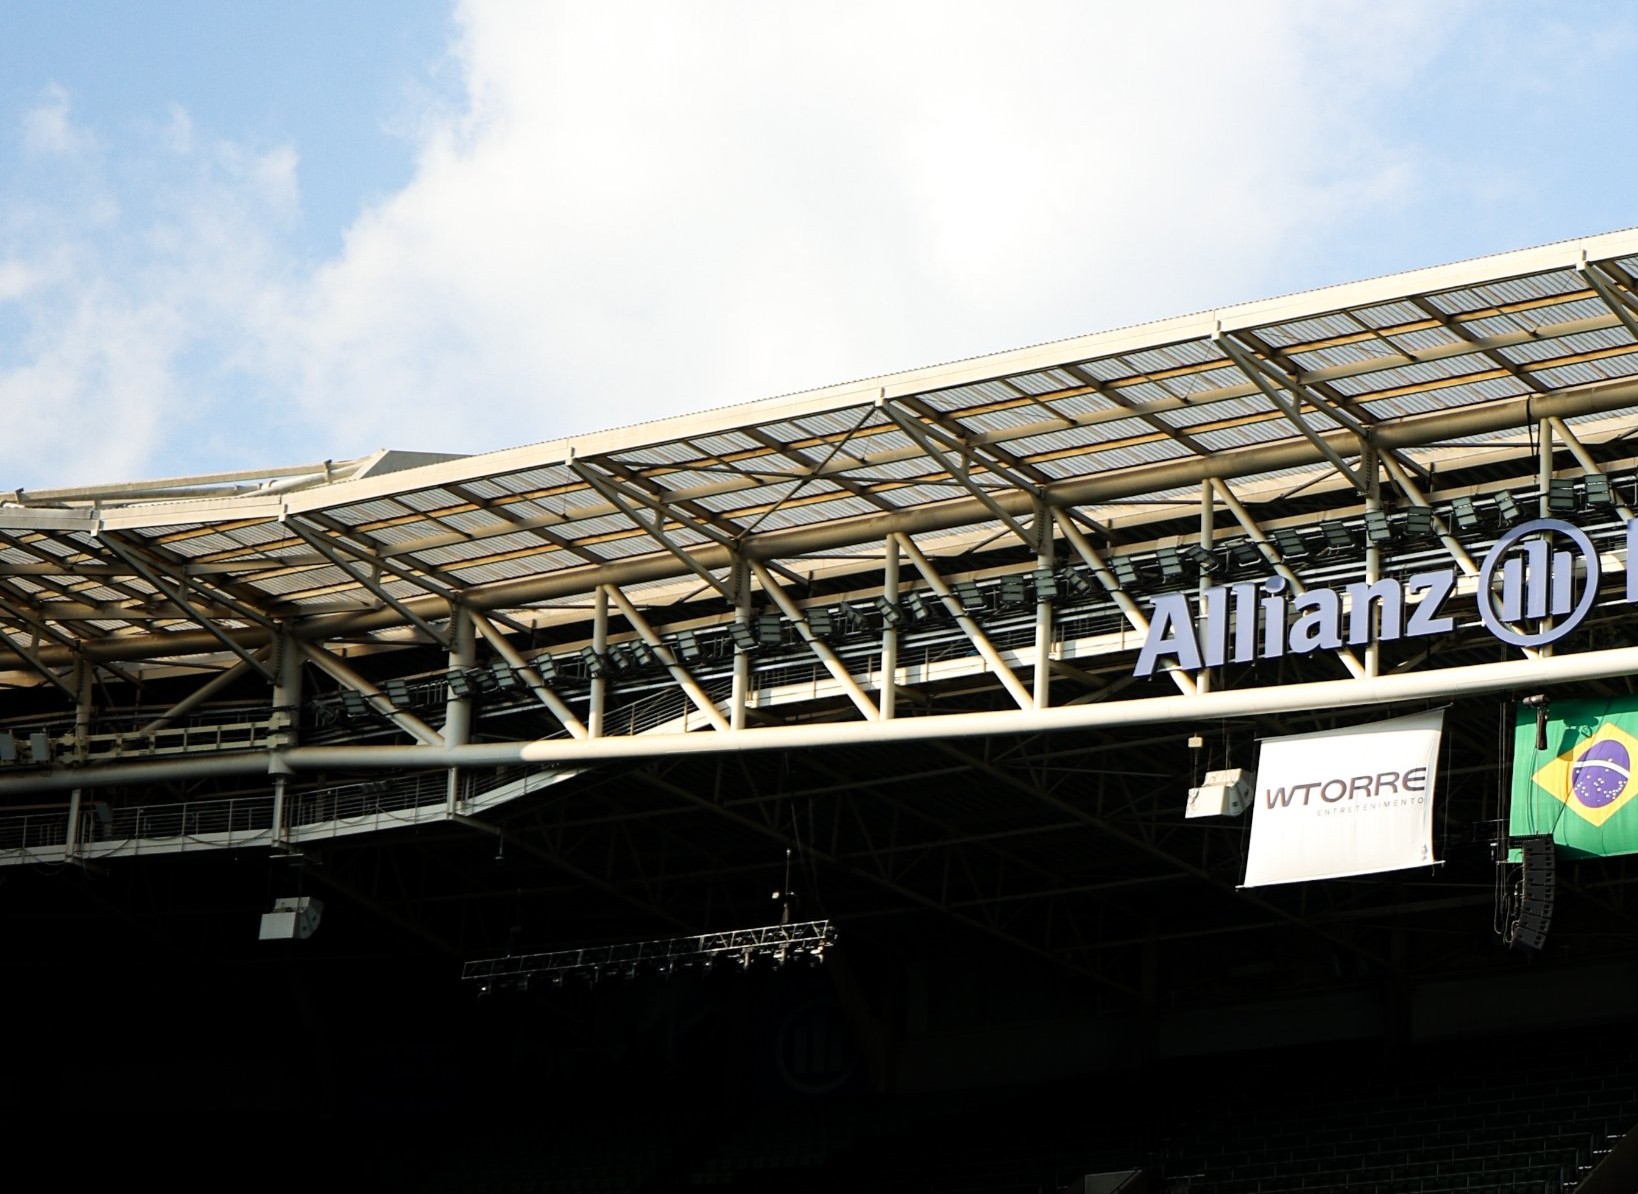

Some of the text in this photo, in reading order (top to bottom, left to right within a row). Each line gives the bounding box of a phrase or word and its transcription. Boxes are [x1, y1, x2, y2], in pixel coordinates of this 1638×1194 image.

[1133, 567, 1459, 678] Allianz
[1266, 767, 1426, 810] WTORRE
[1317, 797, 1424, 816] ENTRETENIMENTO
